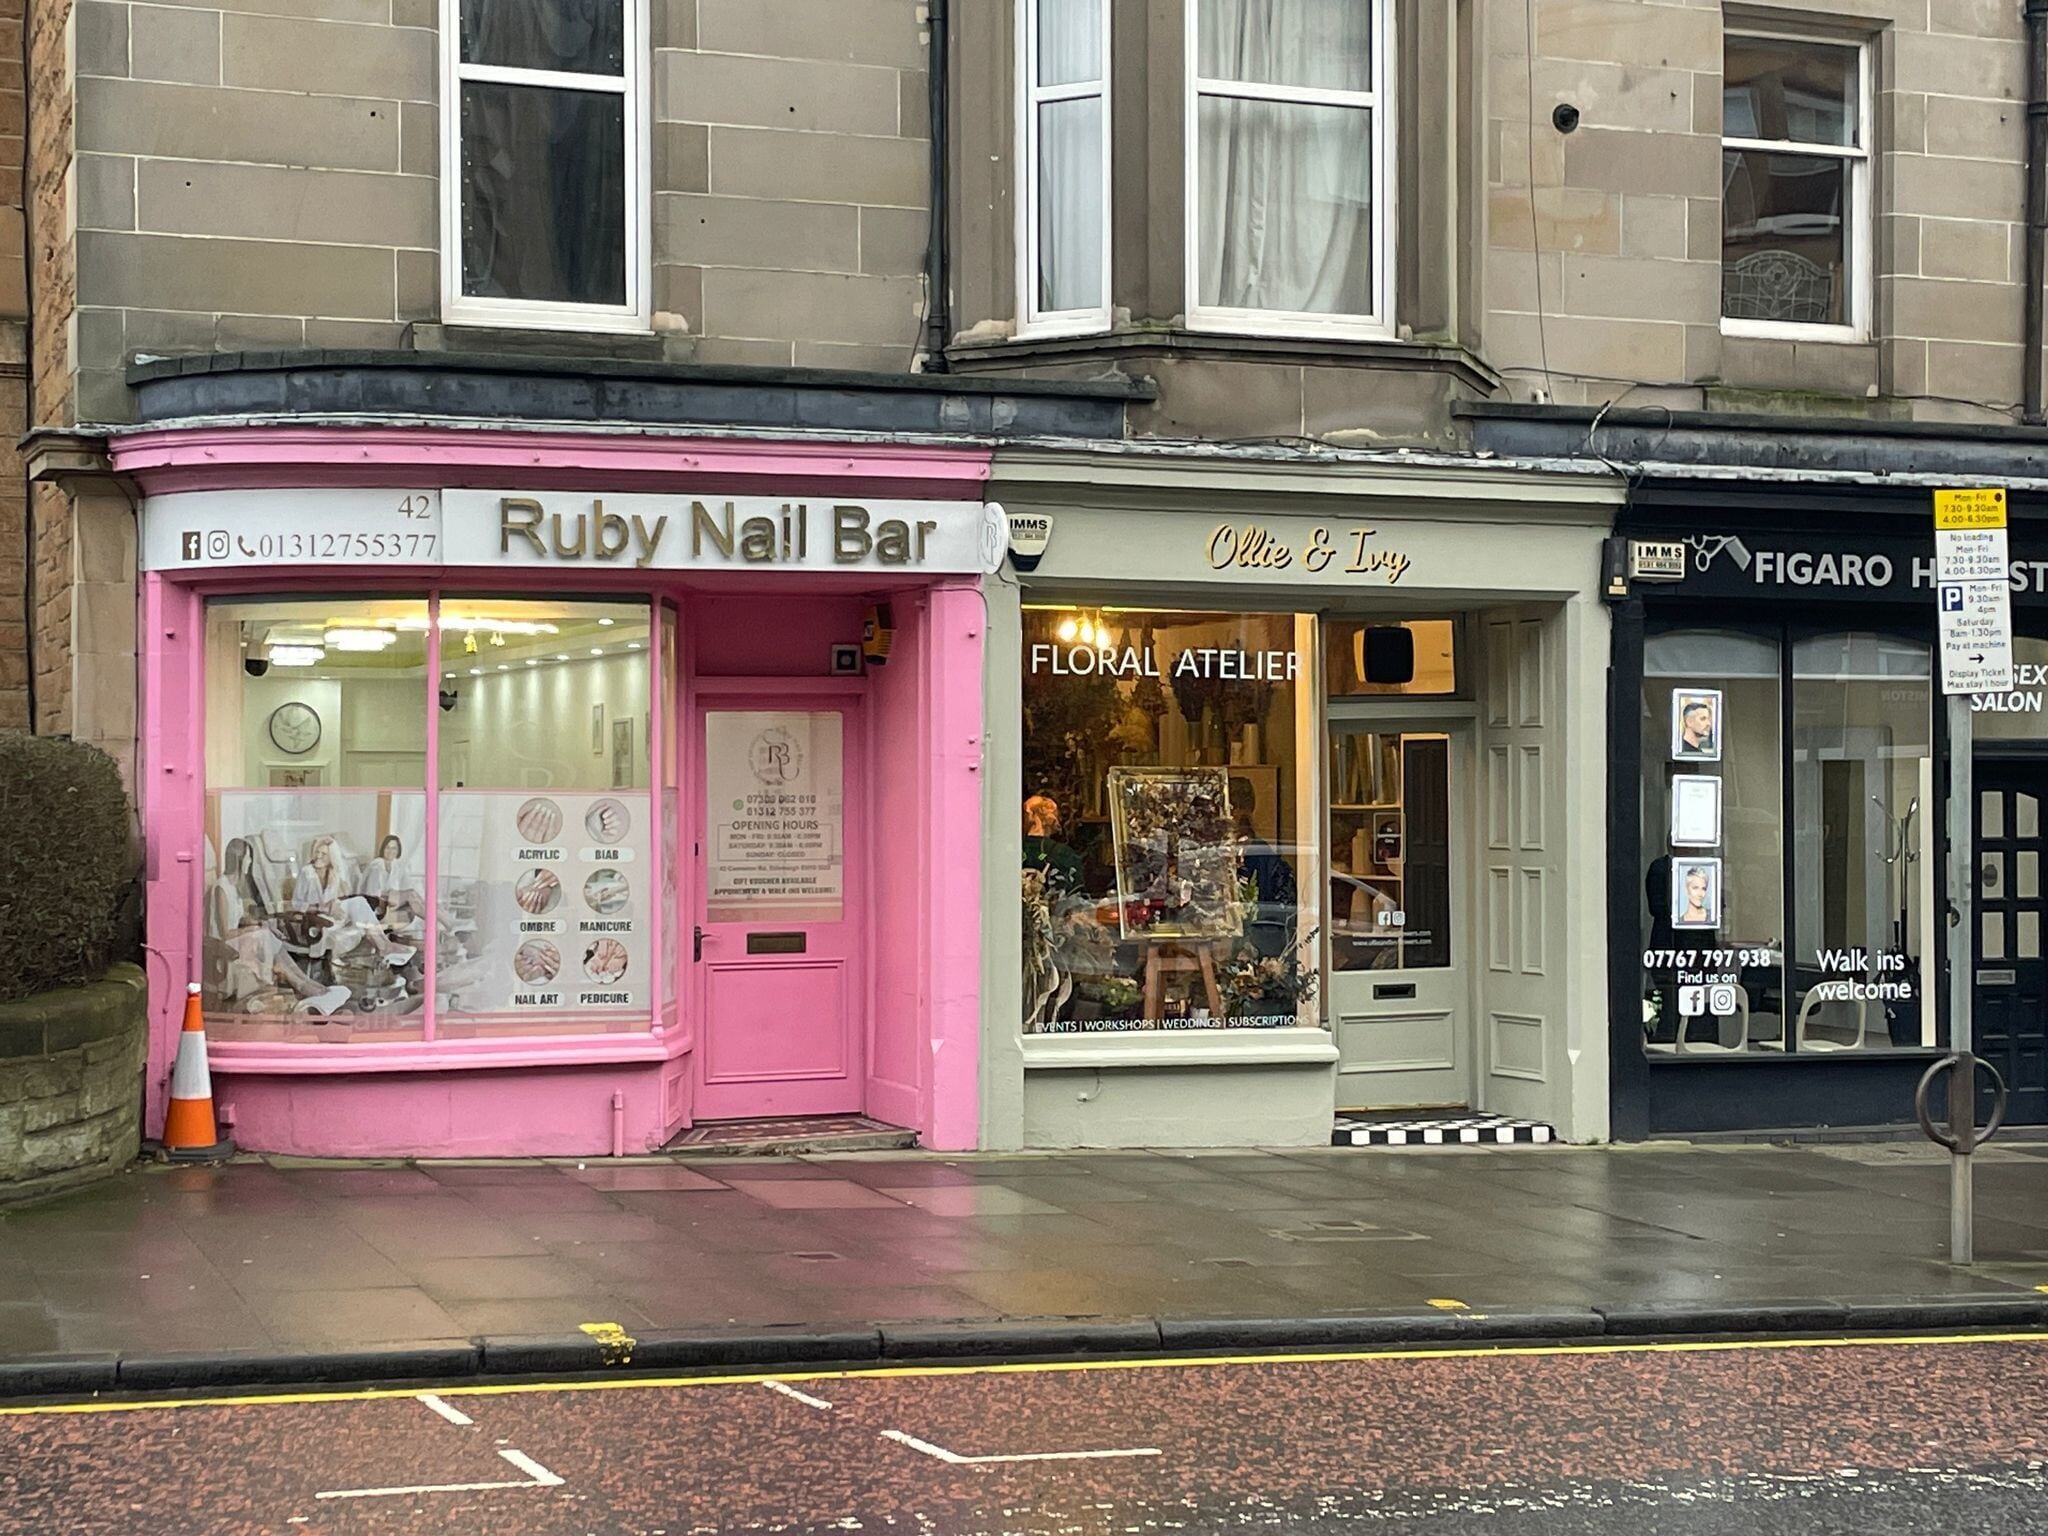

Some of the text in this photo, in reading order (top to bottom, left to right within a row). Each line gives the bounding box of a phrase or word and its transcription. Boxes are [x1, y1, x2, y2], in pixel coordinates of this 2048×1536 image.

[398, 495, 431, 519] 42
[1010, 518, 1047, 530] IMMS
[500, 498, 937, 568] Ruby Nail Bar
[260, 534, 437, 557] 01312755377
[1206, 523, 1410, 584] Ollie & Ivy
[1638, 546, 1682, 558] IMMS
[1756, 552, 1892, 587] FIGARO
[1945, 588, 1960, 611] P
[1978, 606, 1996, 614] 4pm
[1956, 618, 1994, 627] Saturday
[1946, 642, 1961, 651] Pay
[1973, 640, 2006, 649] machine
[1031, 643, 1302, 681] FLORAL ATELIER
[1949, 668, 2006, 679] Display Ticket
[1966, 680, 1983, 689] stay
[1971, 690, 2043, 713] SALON
[746, 806, 776, 816] 01312
[732, 820, 818, 831] OPENING HOURS
[518, 850, 560, 860] ACRYLIC
[595, 849, 619, 860] BIAB
[520, 921, 556, 932] OMBRE
[580, 921, 632, 932] MANICURE
[1643, 950, 1771, 968] 07767 797 938
[1816, 949, 1905, 973] Walk ins
[1677, 970, 1737, 983] Find us on
[1817, 978, 1912, 1001] welcome
[515, 994, 558, 1005] NAIL ART
[580, 993, 629, 1004] PEDICURE
[1035, 1021, 1077, 1032] EVENTS
[1084, 1019, 1155, 1031] WORKSHOPS
[1161, 1018, 1221, 1029] WEDDINGS
